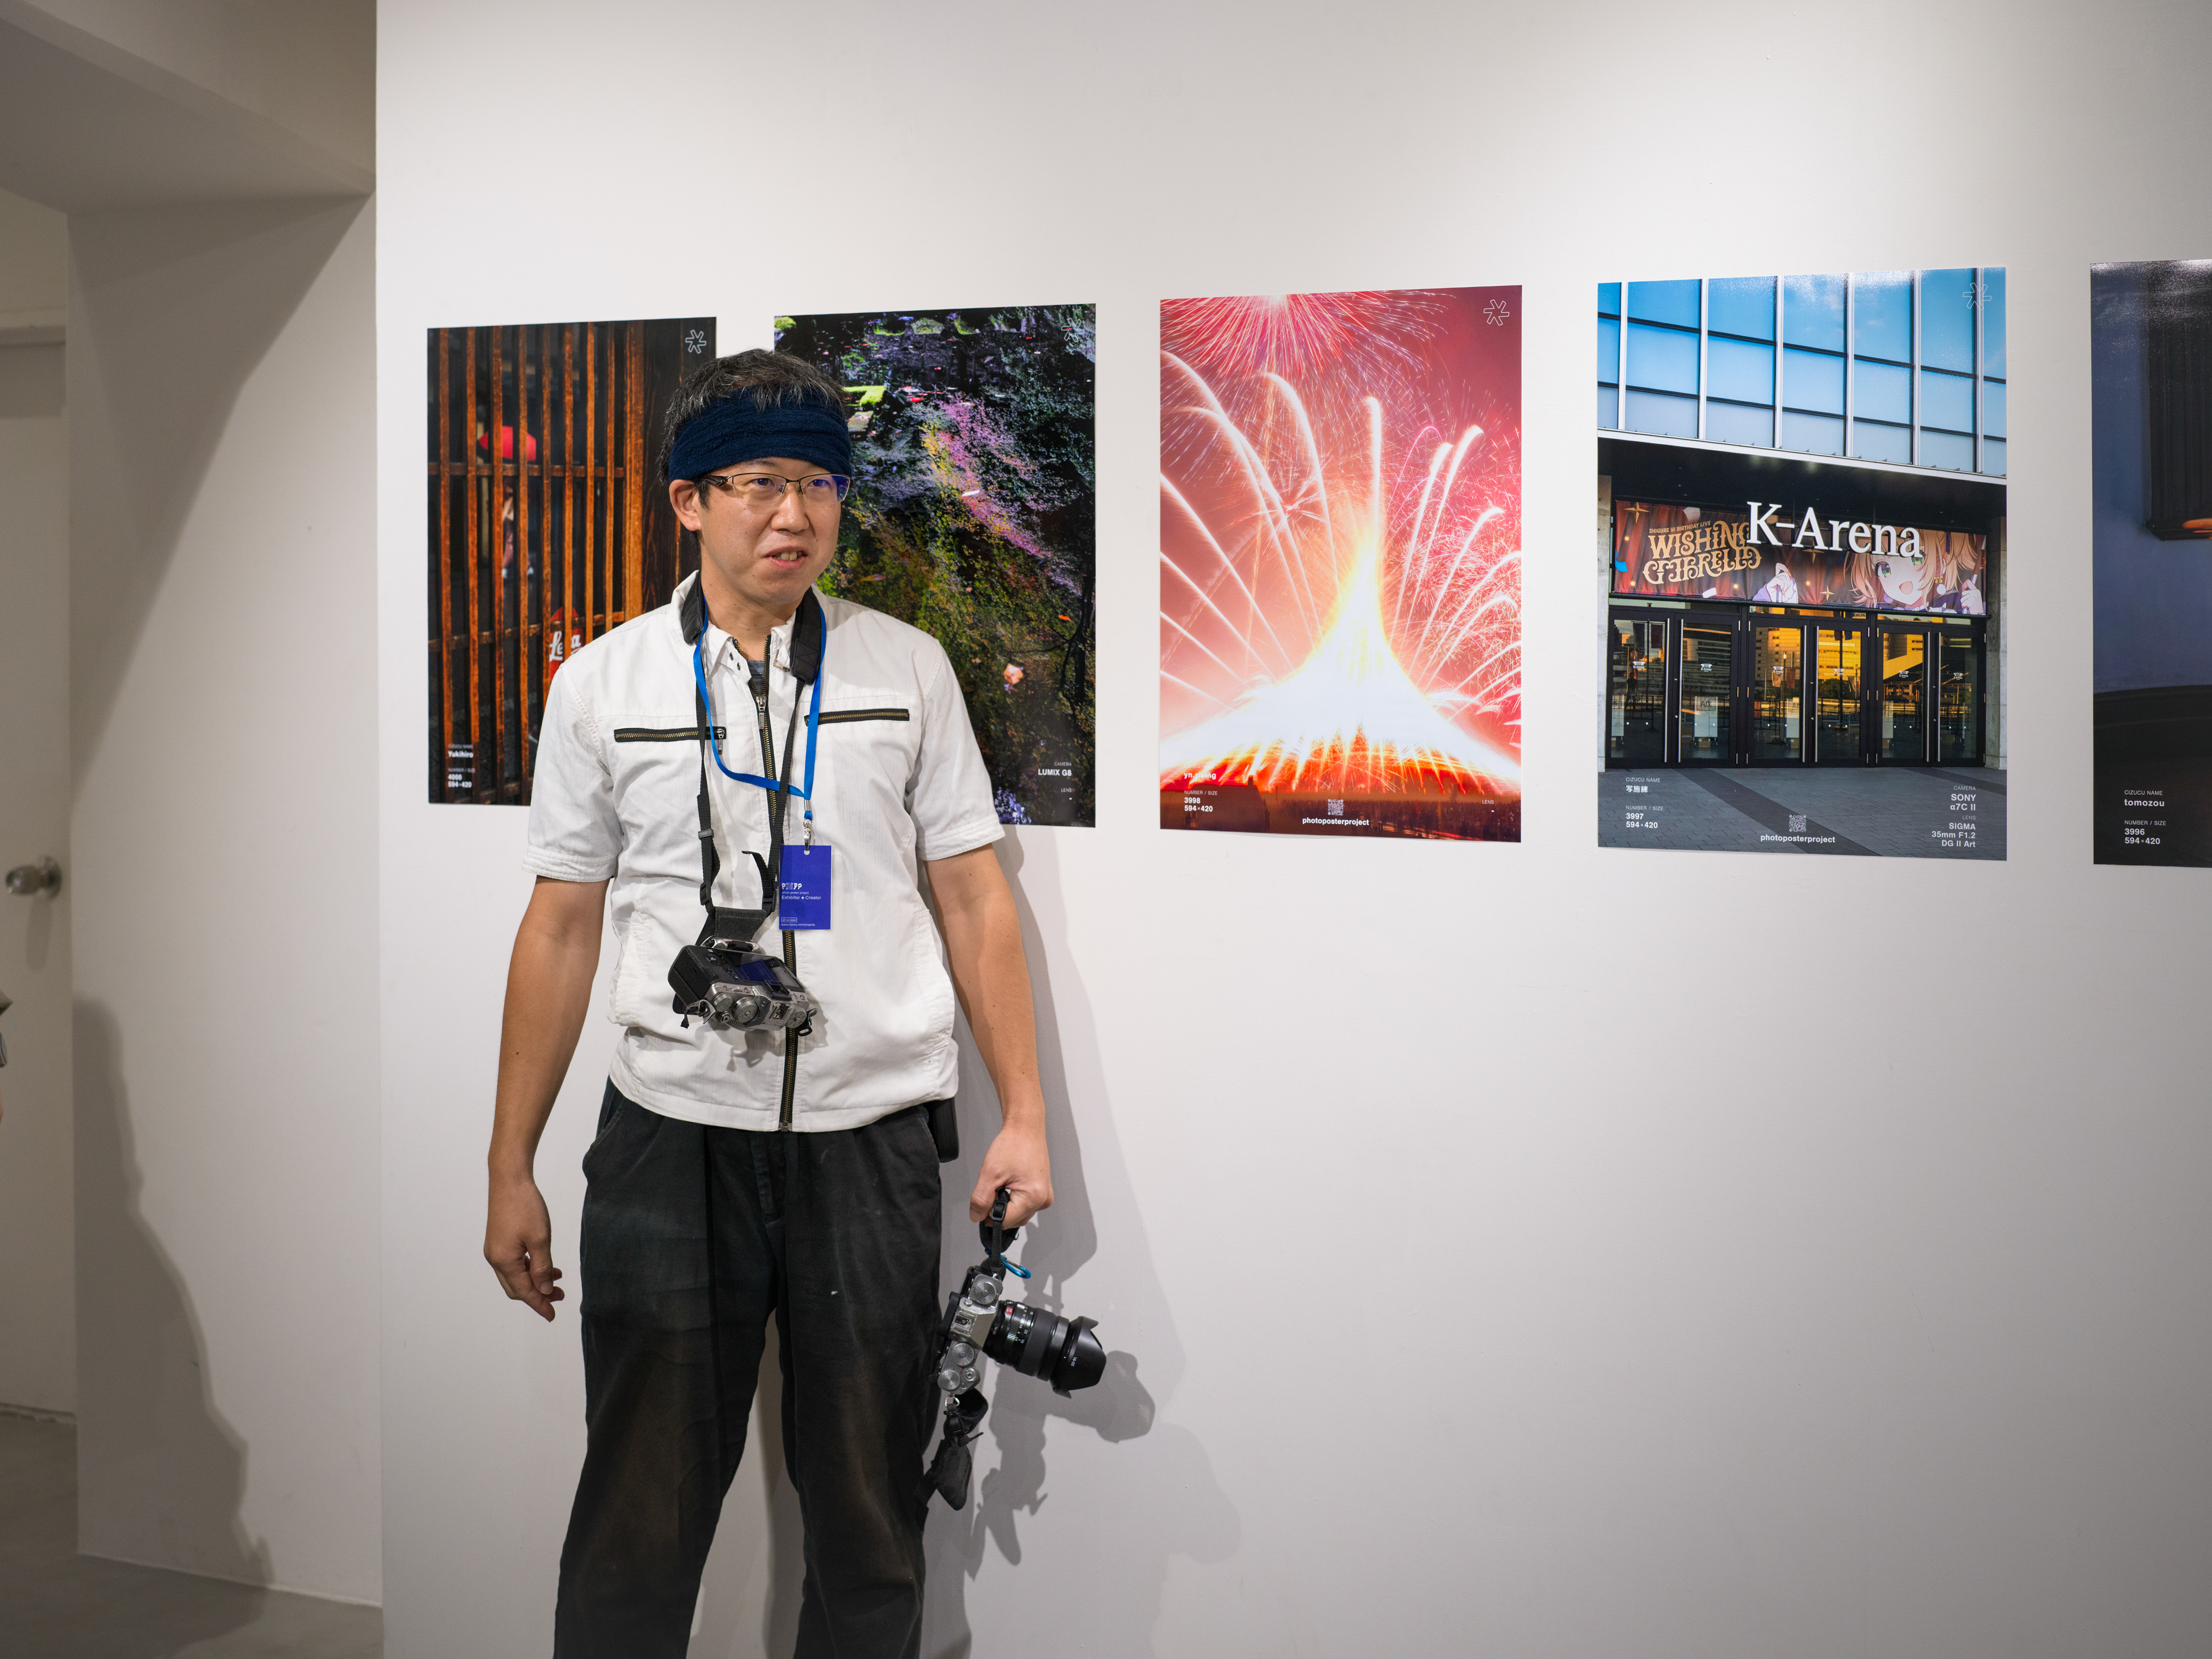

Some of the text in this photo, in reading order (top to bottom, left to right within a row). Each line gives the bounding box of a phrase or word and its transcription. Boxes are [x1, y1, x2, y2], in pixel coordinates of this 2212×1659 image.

[1676, 523, 1699, 531] BIRTHDAY
[1746, 501, 1924, 558] K-Arena
[1184, 771, 1216, 780] yn.rising
[2124, 799, 2165, 807] tomozou
[1302, 817, 1370, 826] photoposterproject
[1760, 834, 1835, 843] photoposterproject
